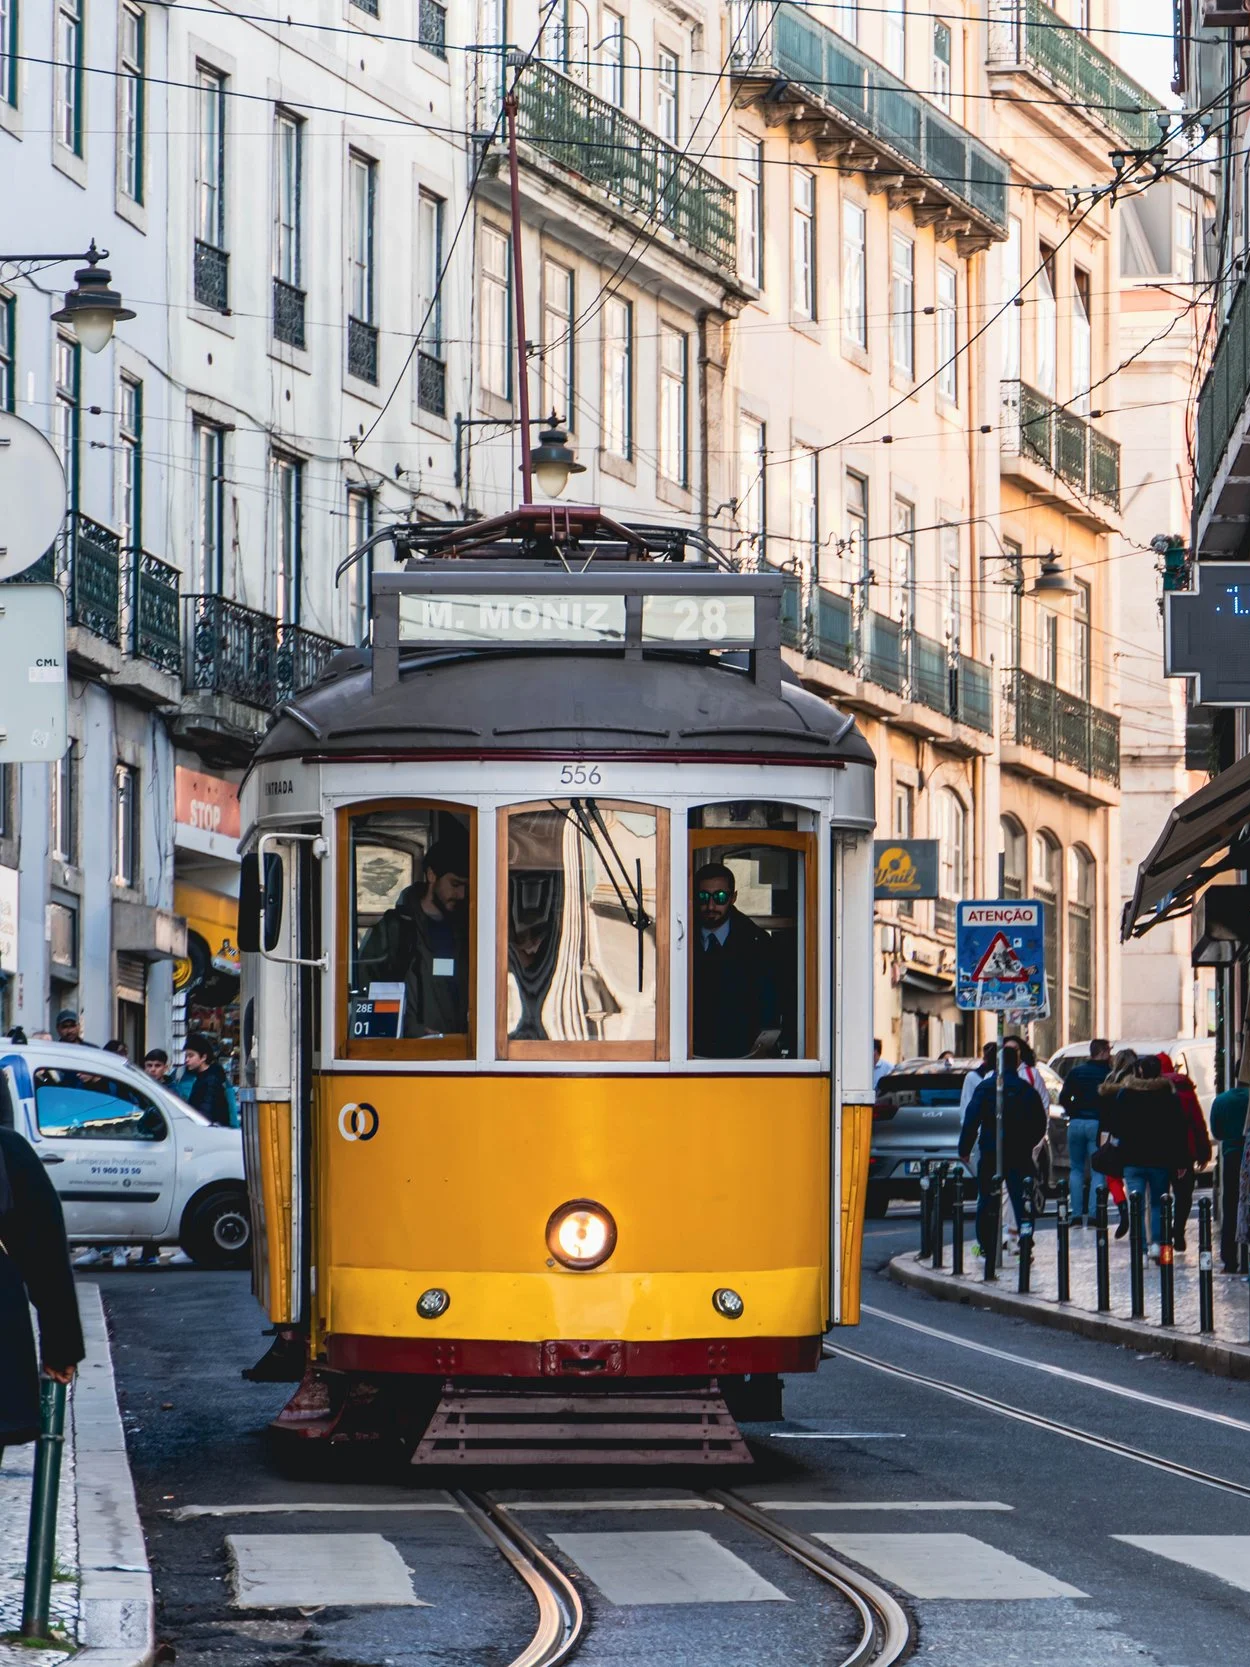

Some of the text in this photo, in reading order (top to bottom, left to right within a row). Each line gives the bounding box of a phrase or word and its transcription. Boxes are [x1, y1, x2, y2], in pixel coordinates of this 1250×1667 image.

[421, 601, 610, 630] M. MONIZ
[673, 598, 728, 641] 28
[36, 658, 59, 667] CML
[560, 764, 602, 785] 556
[265, 780, 294, 796] ENTRADA
[190, 799, 221, 832] STOP
[968, 909, 1033, 924] ATENÇÃO
[356, 1003, 373, 1013] 28E
[354, 1021, 370, 1035] 01
